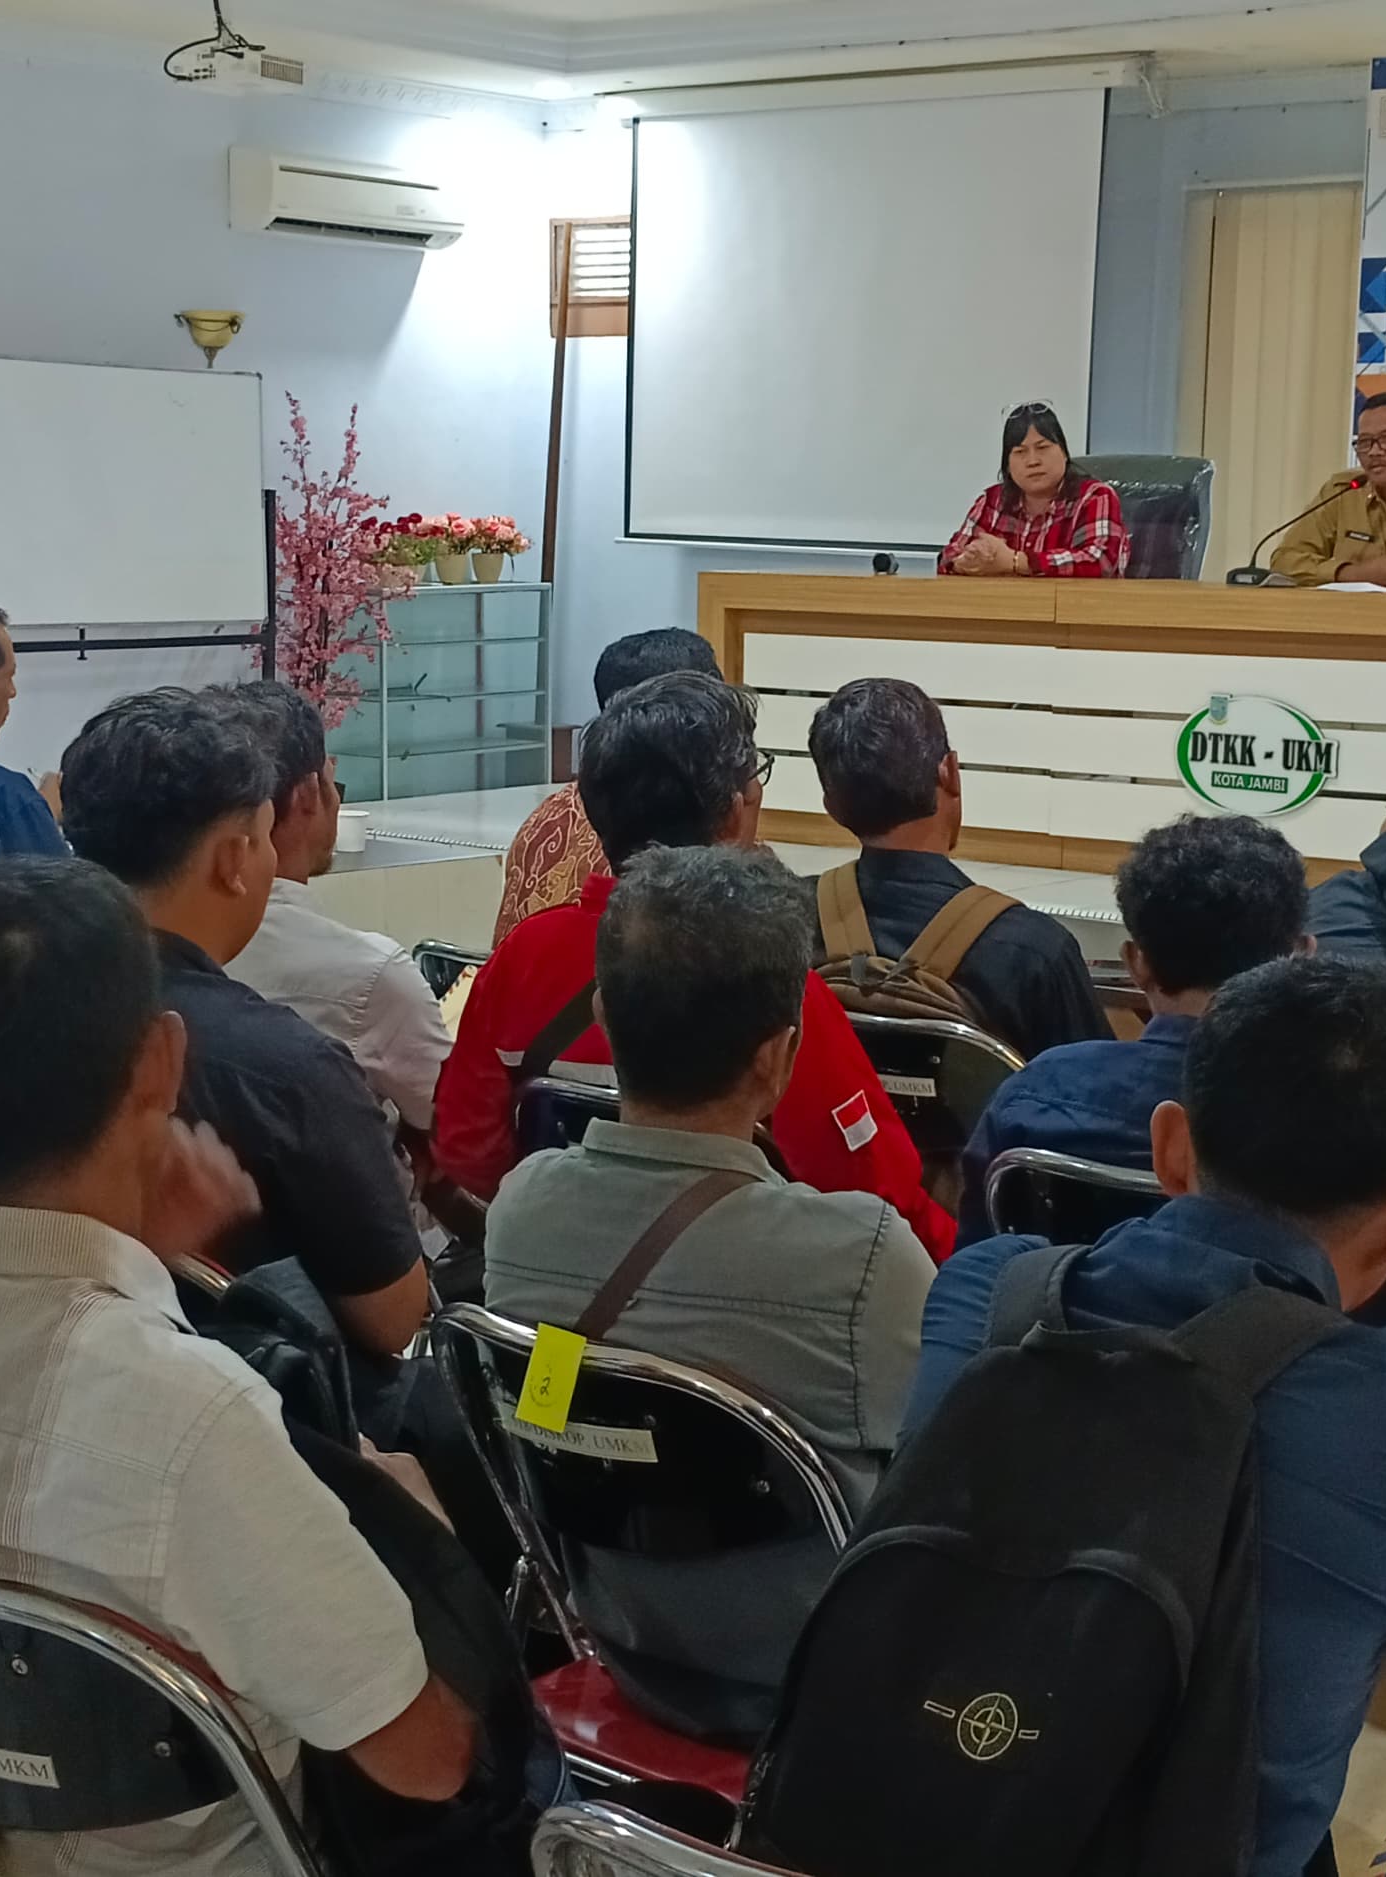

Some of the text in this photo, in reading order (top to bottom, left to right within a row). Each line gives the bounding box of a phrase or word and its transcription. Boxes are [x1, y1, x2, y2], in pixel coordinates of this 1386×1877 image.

[1189, 731, 1335, 774] DTKK - UKM
[1213, 773, 1286, 792] KOTA JAMBI
[539, 1376, 551, 1397] 2
